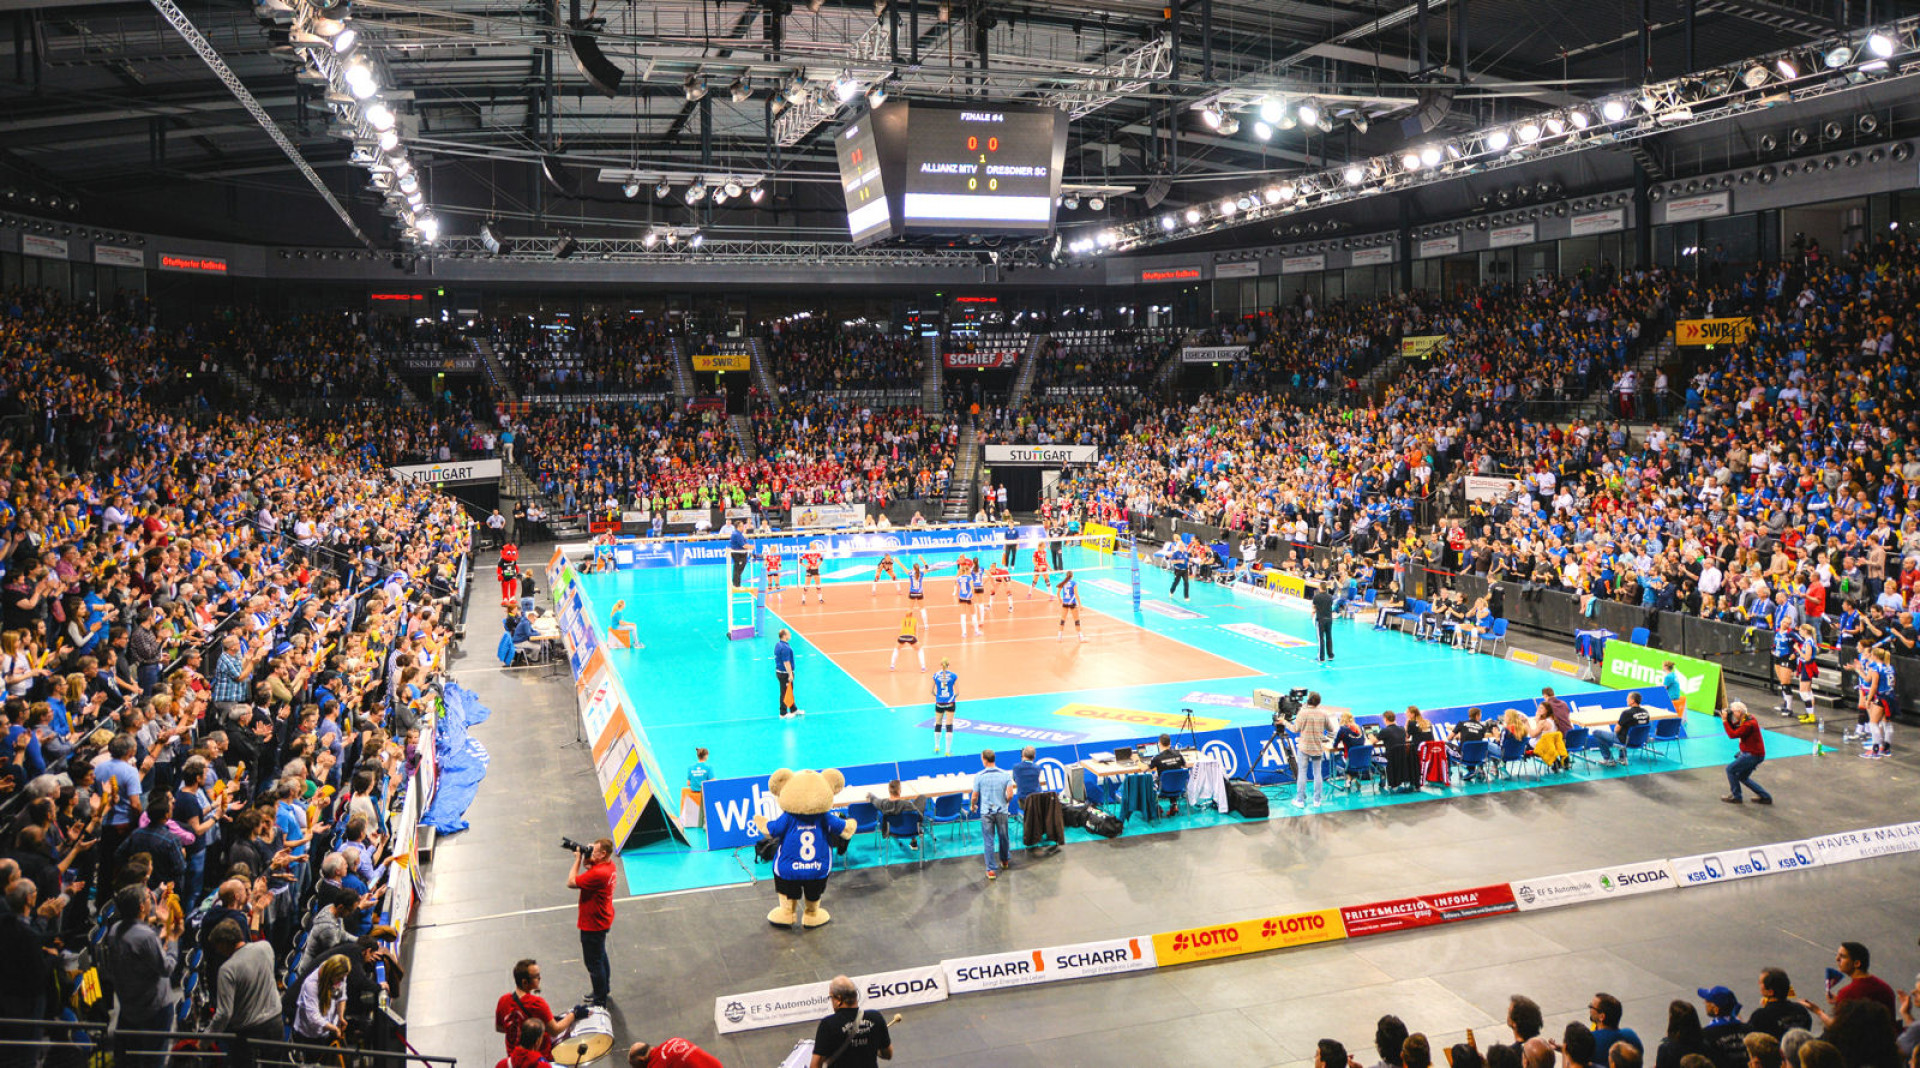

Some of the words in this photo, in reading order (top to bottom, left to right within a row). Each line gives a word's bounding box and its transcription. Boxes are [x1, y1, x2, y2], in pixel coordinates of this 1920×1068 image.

[960, 112, 990, 122] FINALE
[968, 136, 978, 150] 0
[988, 137, 998, 151] 0
[980, 154, 986, 163] 1
[920, 163, 958, 173] ALLIANZ
[958, 164, 977, 174] MTV
[986, 166, 1032, 174] DRESDNER
[1034, 167, 1046, 176] SC
[968, 178, 977, 190] 0
[988, 178, 998, 190] 0
[950, 354, 996, 364] SCHIEF
[1010, 447, 1072, 460] STUTTGART
[413, 465, 473, 482] STUTTGART
[911, 536, 954, 547] Allianz
[1611, 658, 1666, 688] erima
[1074, 709, 1167, 726] LOTTO
[974, 723, 1076, 741] Allianz
[800, 831, 816, 862] 8
[1816, 834, 1860, 850] HAVER
[1862, 832, 1870, 842] &
[792, 862, 822, 871] Charly
[1733, 864, 1752, 874] KSB
[1778, 858, 1798, 868] KSB
[1618, 870, 1669, 886] ŠKODA
[1687, 871, 1707, 882] KSB
[1346, 900, 1430, 920] FRITZ&MACZIOL
[1279, 914, 1324, 934] LOTTO
[1191, 928, 1238, 948] LOTTO
[1056, 948, 1127, 969] SCHARR
[957, 961, 1029, 982] SCHARR
[868, 978, 938, 998] ŠKODA
[750, 1006, 762, 1015] EF
[765, 1002, 772, 1012] S
